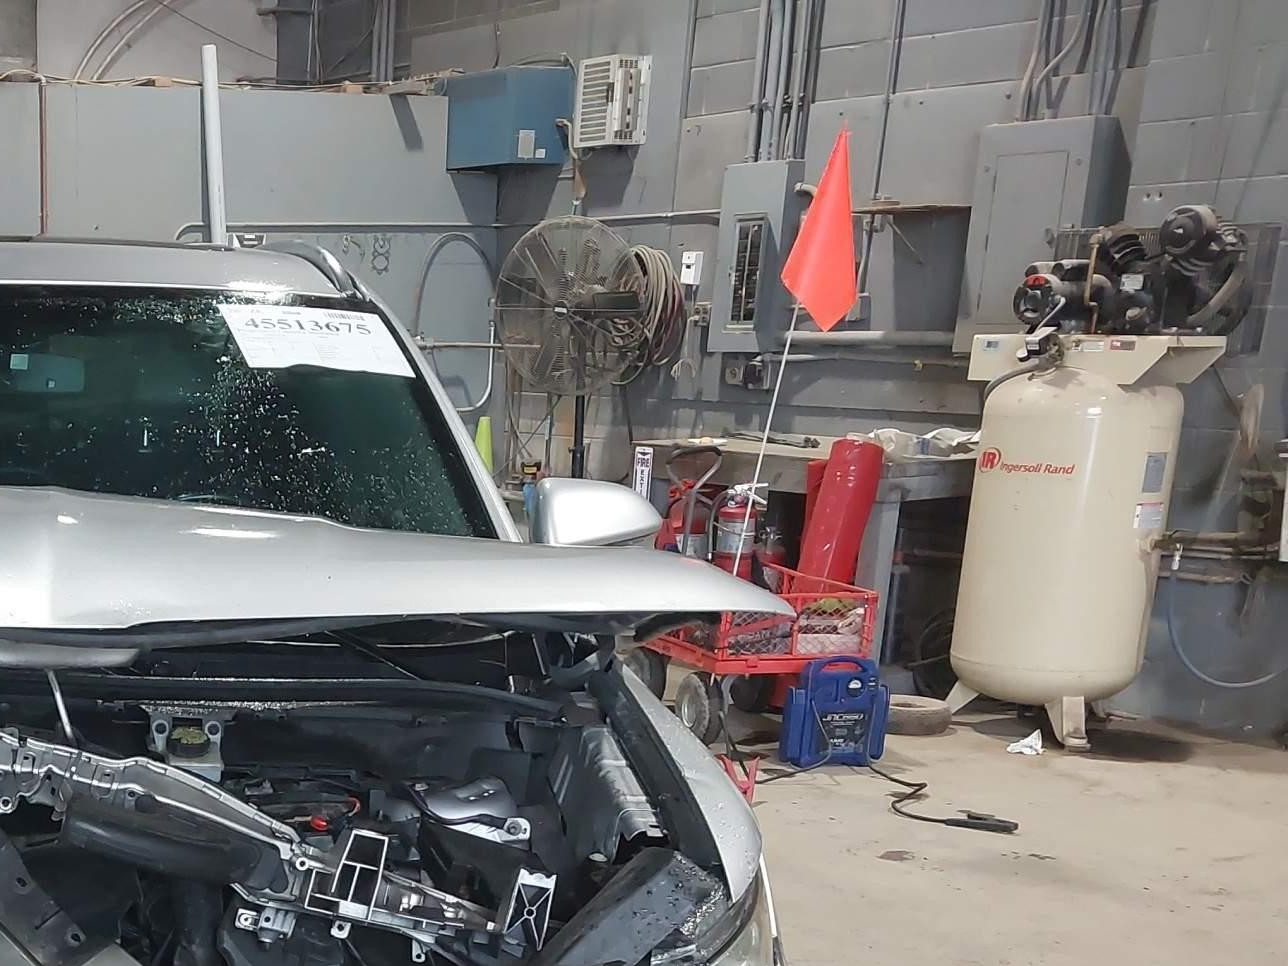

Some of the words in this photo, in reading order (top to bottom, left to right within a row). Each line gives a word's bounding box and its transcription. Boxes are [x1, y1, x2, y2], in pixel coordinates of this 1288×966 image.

[244, 317, 372, 335] 45513675
[637, 457, 650, 468] FIRE
[1000, 461, 1042, 474] Ingersoll
[1043, 463, 1076, 475] Rand
